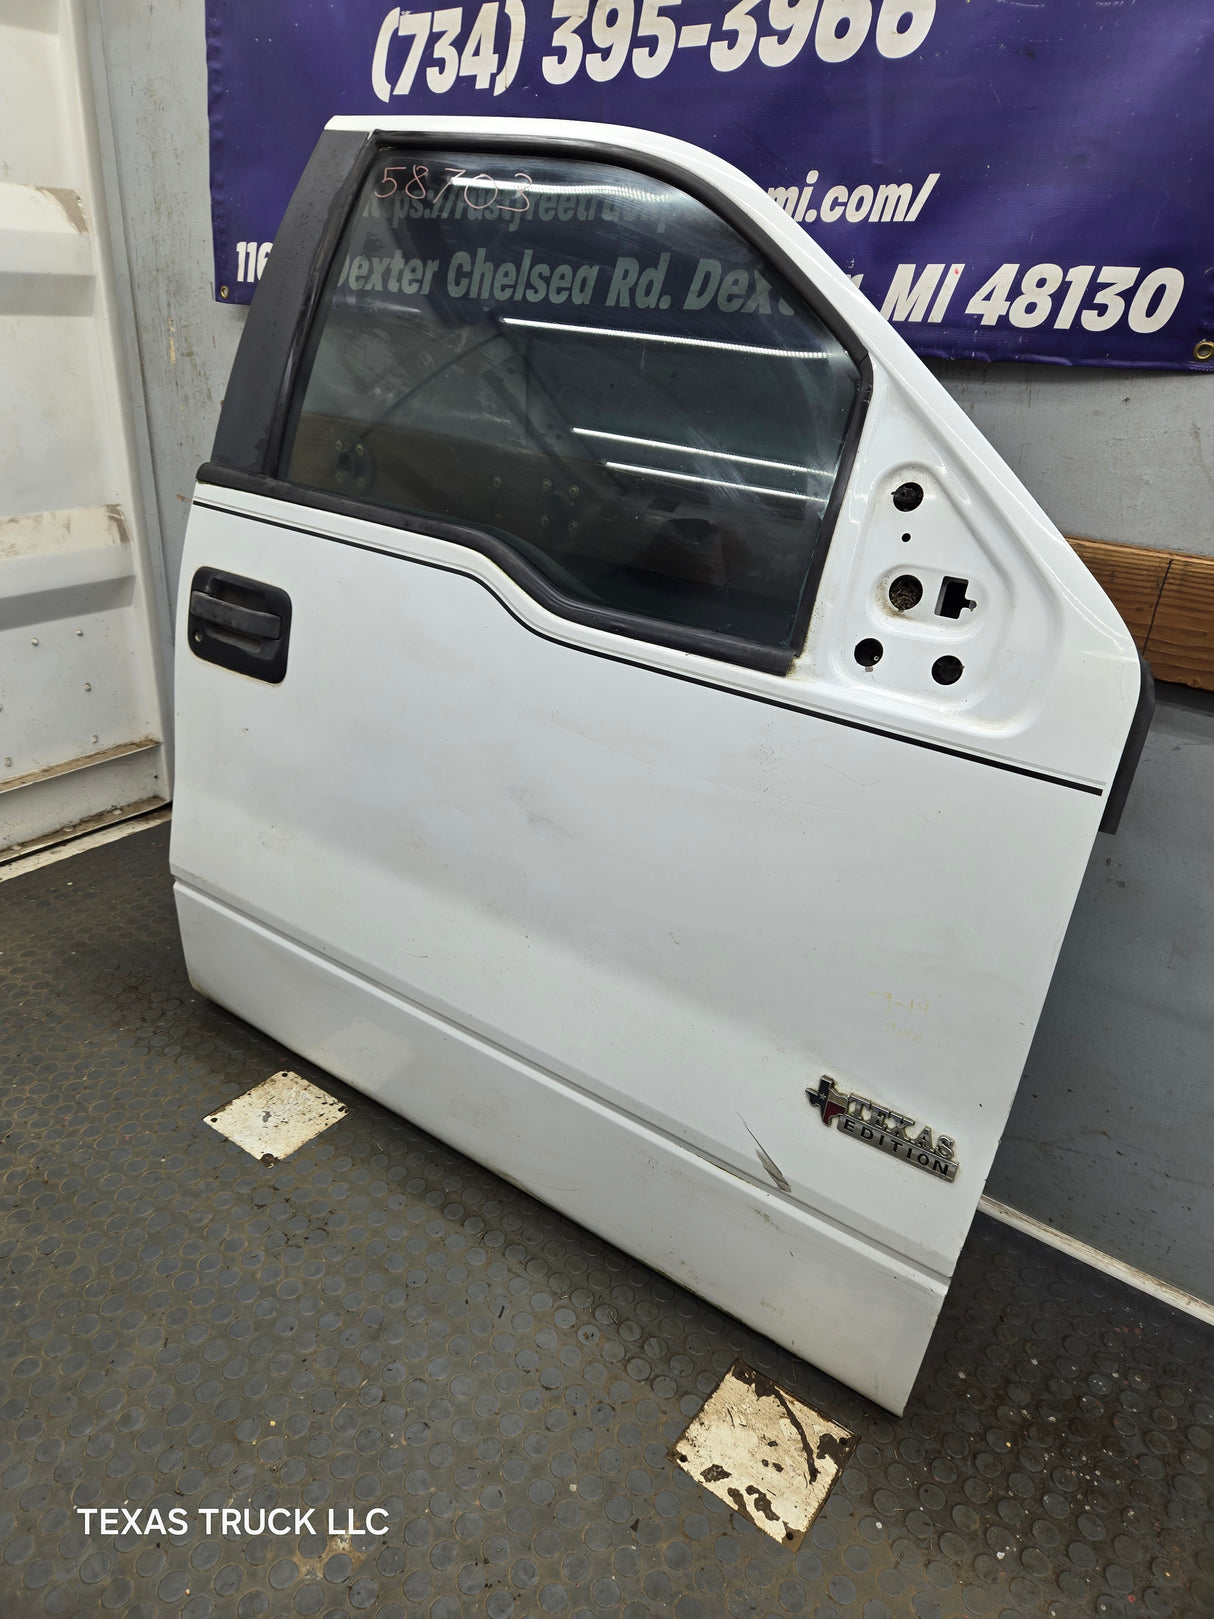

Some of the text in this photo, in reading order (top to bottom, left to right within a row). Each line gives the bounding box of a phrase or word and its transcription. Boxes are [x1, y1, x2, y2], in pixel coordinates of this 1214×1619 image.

[371, 0, 526, 104] (734)
[374, 164, 533, 212] 58703
[337, 249, 440, 295] exter
[447, 247, 600, 306] Chelsea
[604, 252, 672, 311] Rd.
[880, 263, 966, 323] MI
[964, 262, 1185, 334] 48130
[843, 1118, 950, 1177] EDITION
[848, 1093, 955, 1159] TEXAS
